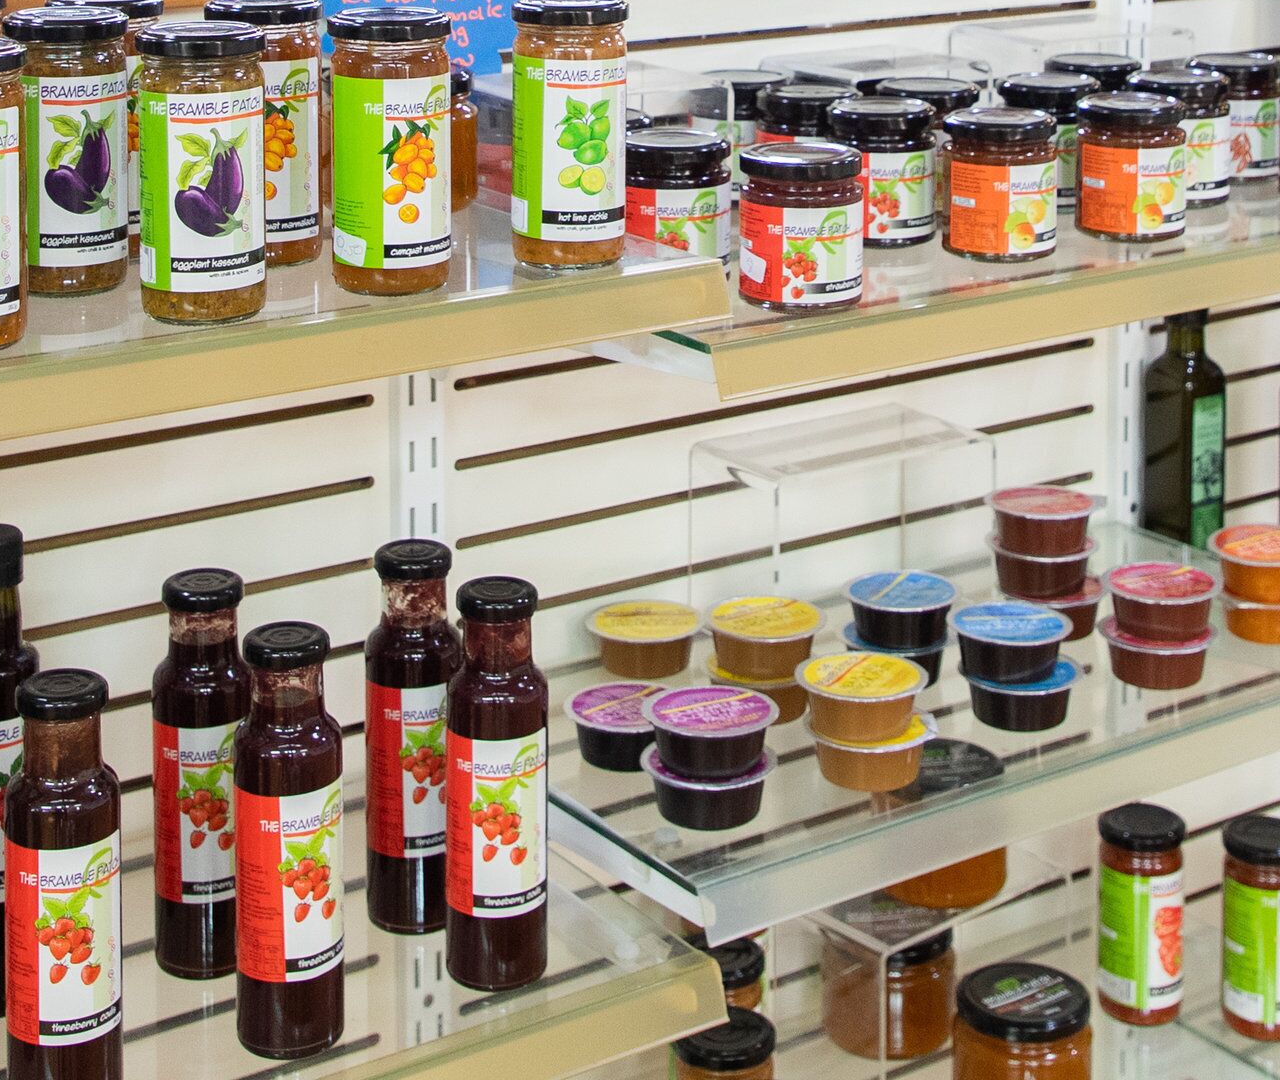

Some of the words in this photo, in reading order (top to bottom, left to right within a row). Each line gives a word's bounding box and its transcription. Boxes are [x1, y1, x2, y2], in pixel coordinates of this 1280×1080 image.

[526, 66, 543, 80] THE
[546, 69, 602, 82] BRAMBLE
[602, 65, 625, 80] PATCH
[41, 84, 99, 98] BRAMBLE
[102, 80, 125, 96] PATCH
[149, 101, 166, 115] THE
[169, 101, 230, 115] BRAMBLE
[231, 95, 260, 112] PATCH
[364, 103, 383, 115] THE
[385, 103, 433, 115] BRAMBLE
[1122, 164, 1137, 173] THE
[993, 181, 1009, 192] THE
[558, 213, 570, 222] hot
[571, 213, 586, 222] lime
[587, 211, 608, 222] pickle
[640, 205, 655, 216] THE
[657, 206, 697, 216] BRAMBLE
[768, 224, 782, 235] THE
[784, 225, 827, 236] BRAMBLE
[41, 233, 79, 247] eggplant
[80, 231, 115, 244] kassoundi
[390, 244, 422, 257] cumquat
[172, 259, 210, 272] eggplant
[212, 254, 249, 267] kassoundi
[384, 709, 401, 721] THE
[163, 748, 178, 762] THE
[180, 748, 229, 764] BRAMBLE
[456, 758, 472, 772] THE
[474, 760, 523, 776] BRAMBLE
[260, 820, 279, 834] THE
[282, 812, 330, 833] BRAMBLE
[19, 871, 37, 886] THE
[40, 868, 96, 887] BRAMBLE
[483, 893, 524, 907] threeberry
[298, 949, 336, 969] threeberry
[51, 1017, 98, 1033] threeberry
